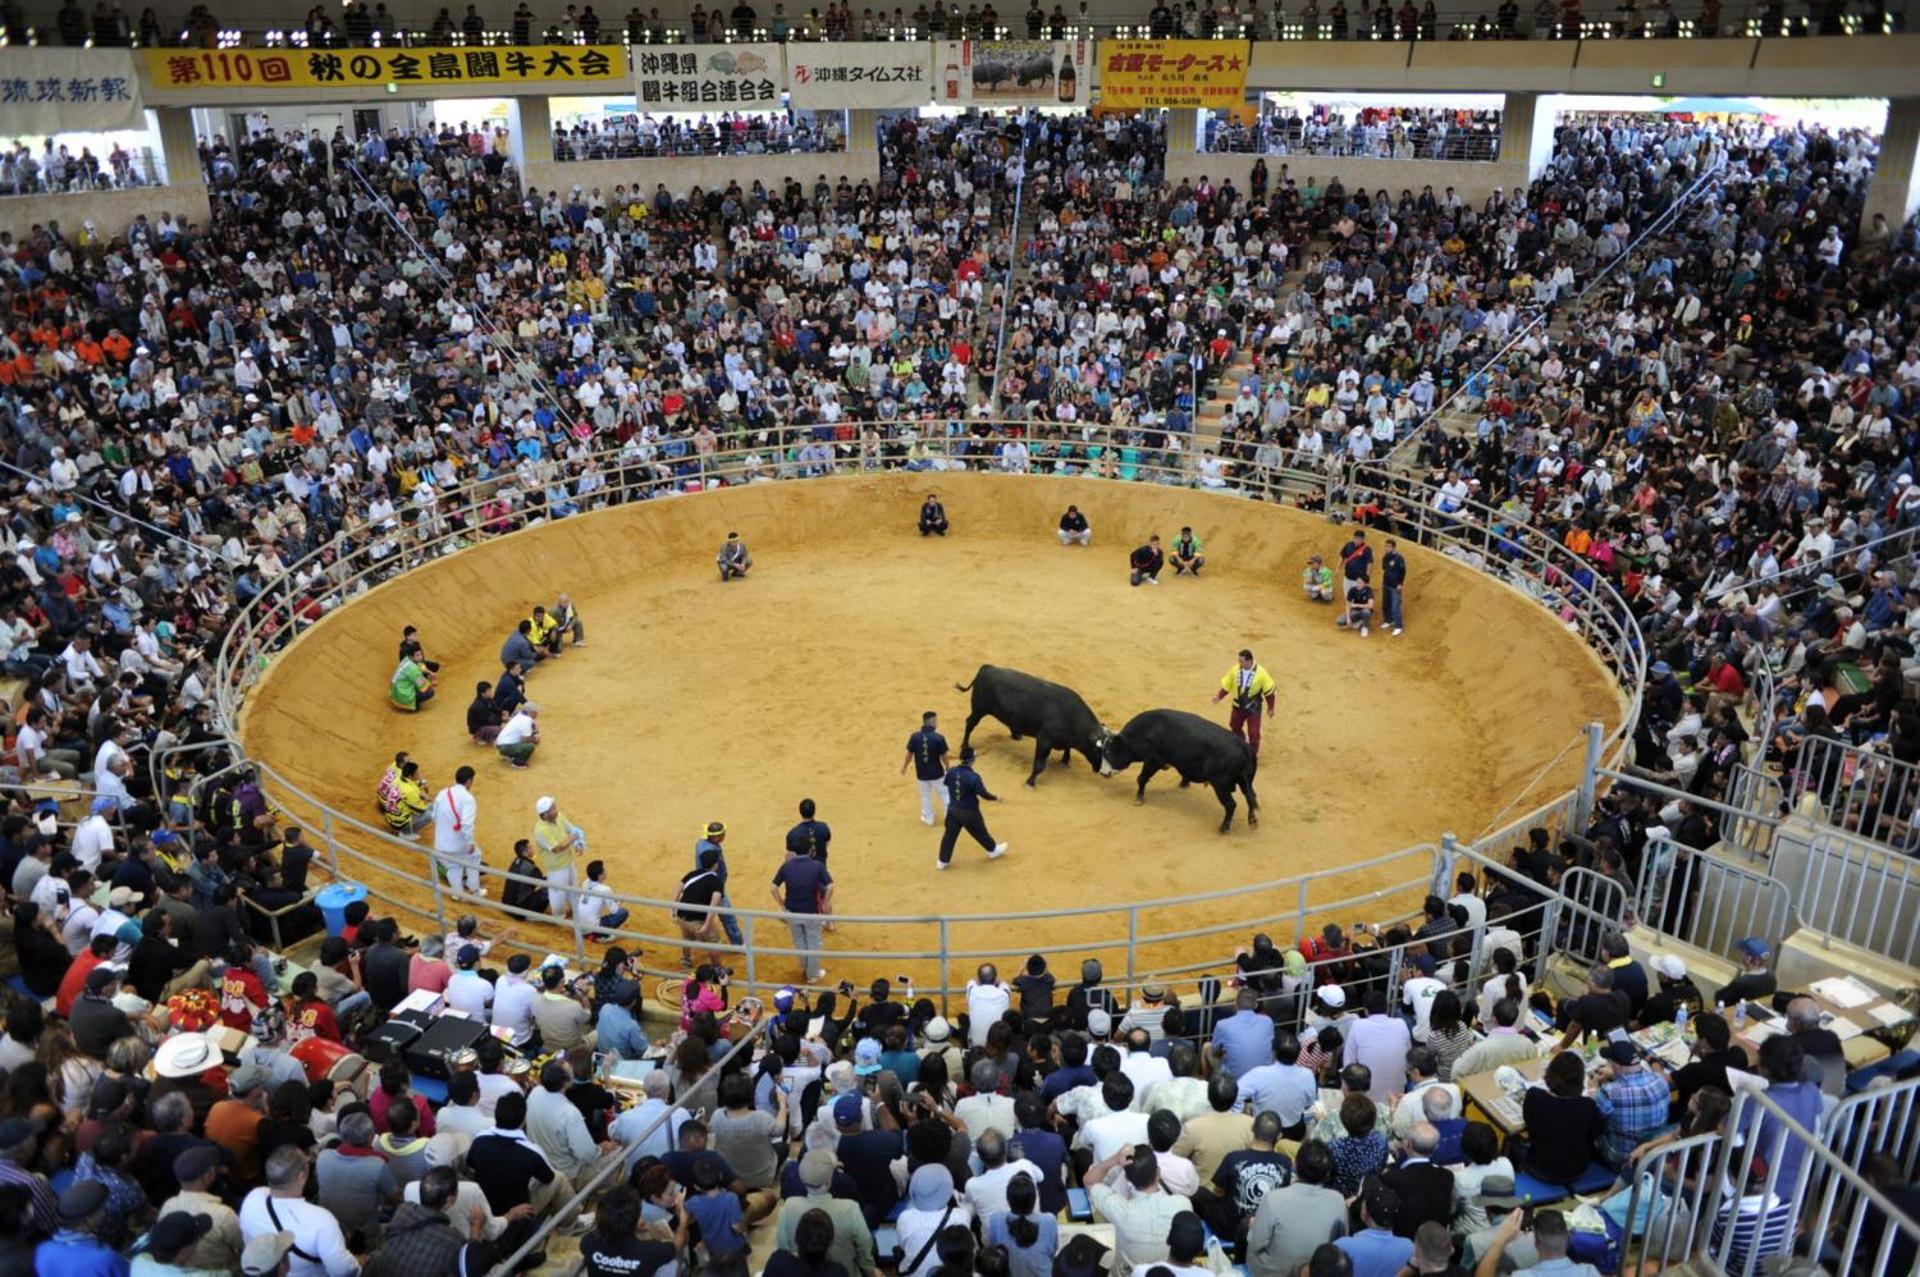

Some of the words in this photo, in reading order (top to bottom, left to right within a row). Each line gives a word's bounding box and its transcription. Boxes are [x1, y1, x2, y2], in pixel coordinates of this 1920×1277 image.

[167, 53, 292, 84] 第110回
[308, 50, 610, 81] 秋の全島闘牛大会
[641, 52, 698, 76] 沖縄県
[814, 65, 923, 83] 沖縄タイムス社
[1, 77, 132, 102] 琉球新報
[642, 79, 775, 102] 闘牛組合連合会
[1144, 97, 1160, 105] TEL
